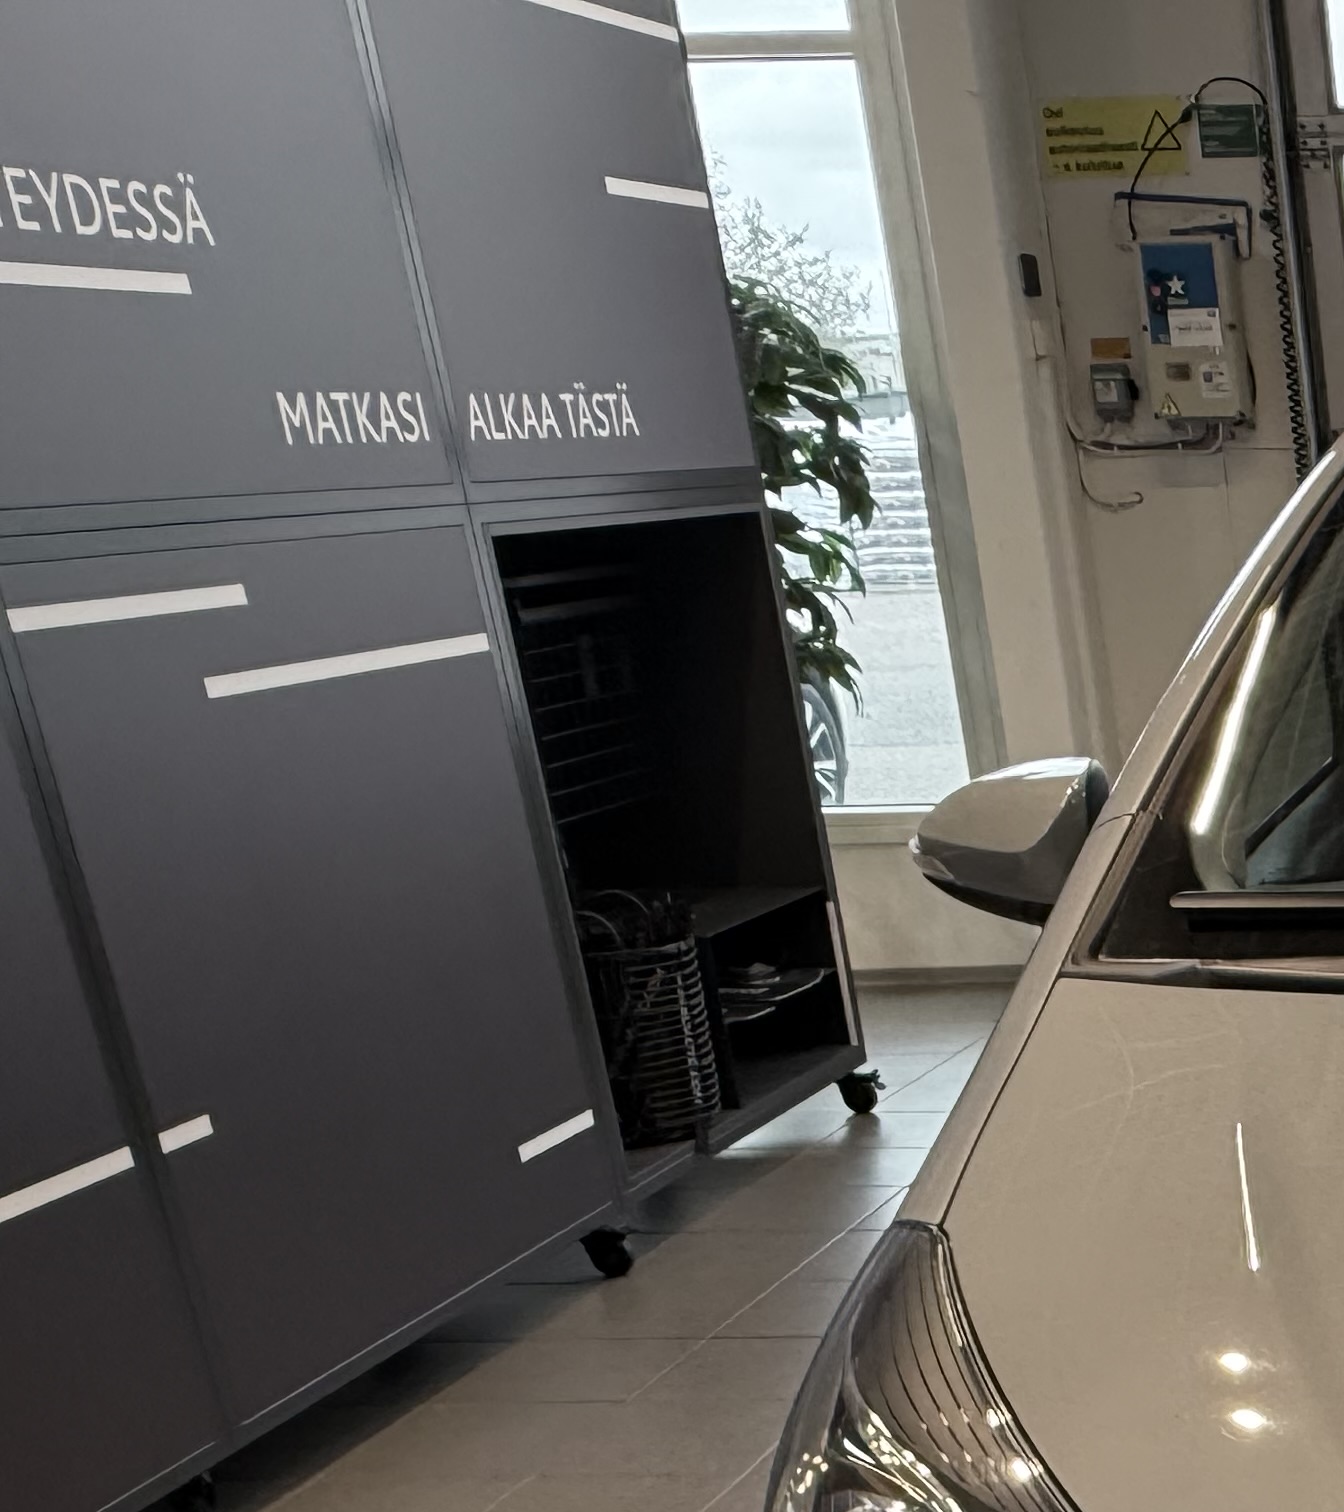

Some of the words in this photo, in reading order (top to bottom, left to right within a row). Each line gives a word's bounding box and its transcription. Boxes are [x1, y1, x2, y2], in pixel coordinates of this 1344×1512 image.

[0, 167, 216, 247] EYDESSÄ
[276, 391, 430, 446] MATKASI
[469, 393, 561, 441] ALKAA
[562, 382, 640, 439] TÄSTÄ
